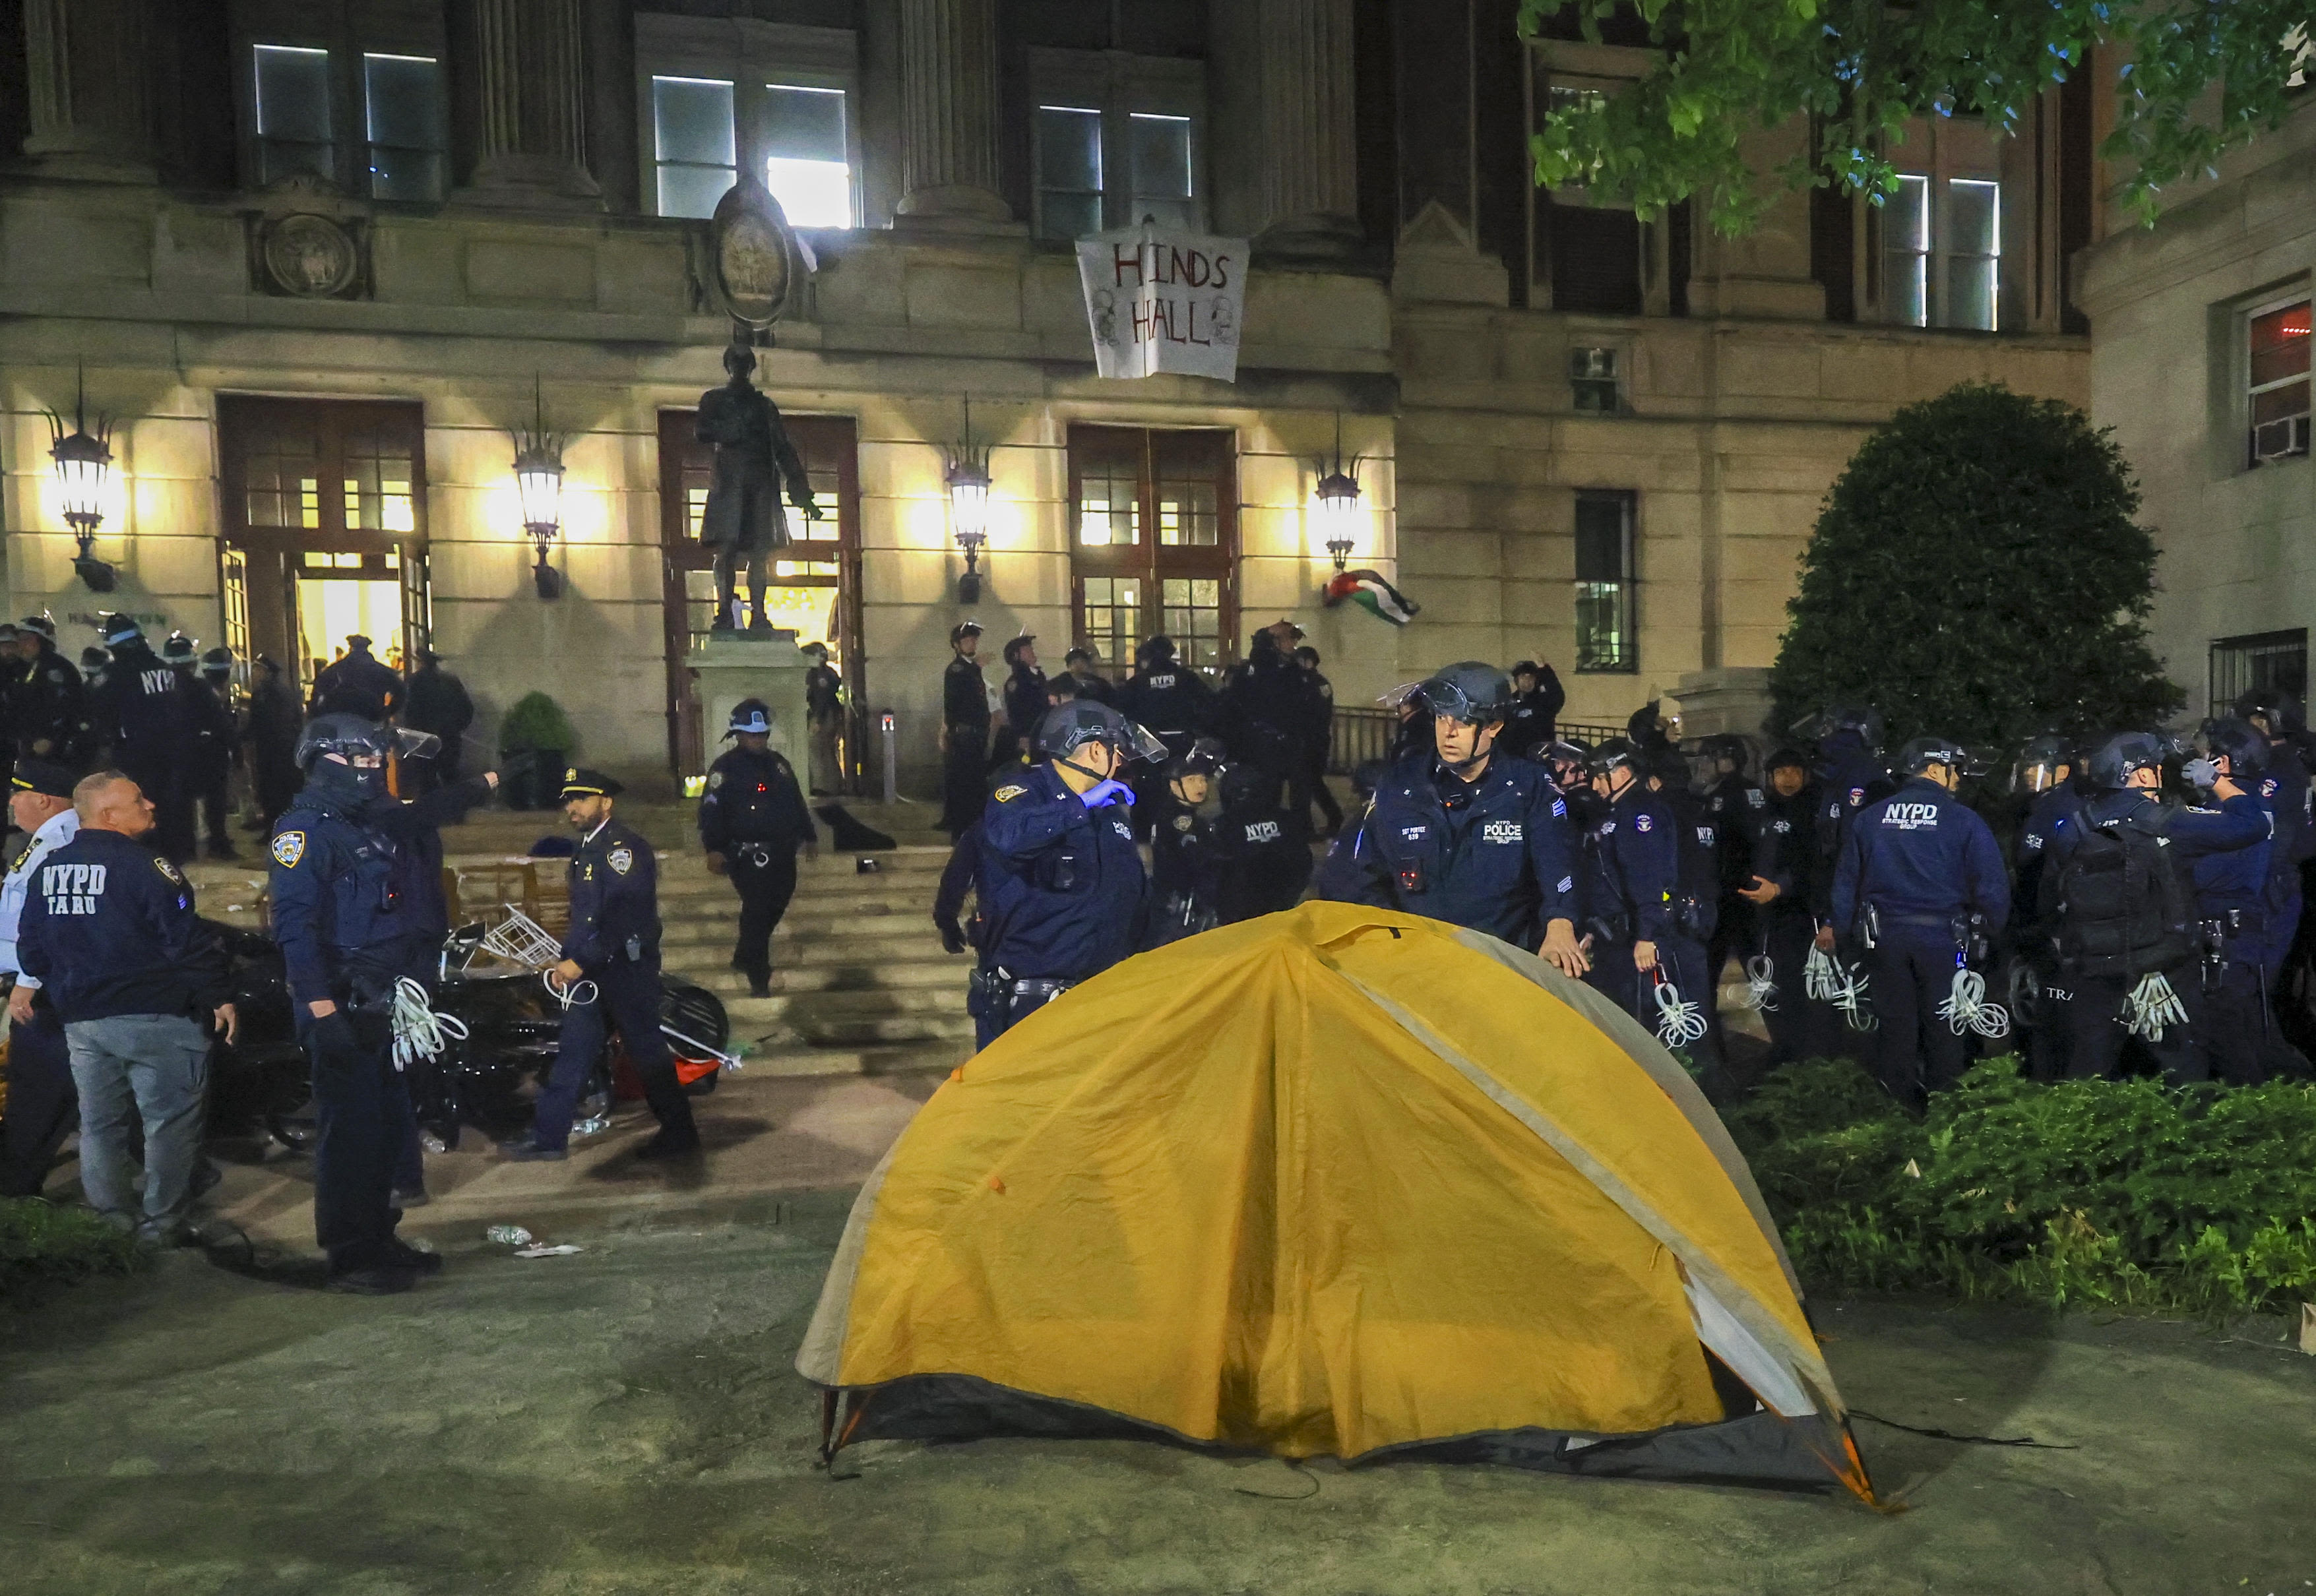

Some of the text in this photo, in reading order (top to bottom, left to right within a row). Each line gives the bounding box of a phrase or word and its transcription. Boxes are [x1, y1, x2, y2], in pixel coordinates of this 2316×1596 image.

[1113, 243, 1230, 289] HINDS
[1131, 297, 1210, 347] HALL
[1885, 803, 1938, 820] NYPD
[1245, 821, 1278, 838] NYPD
[1484, 824, 1522, 836] POLICE
[1696, 826, 1714, 840] NYP
[42, 863, 107, 896] NYPD
[47, 896, 96, 915] TARU
